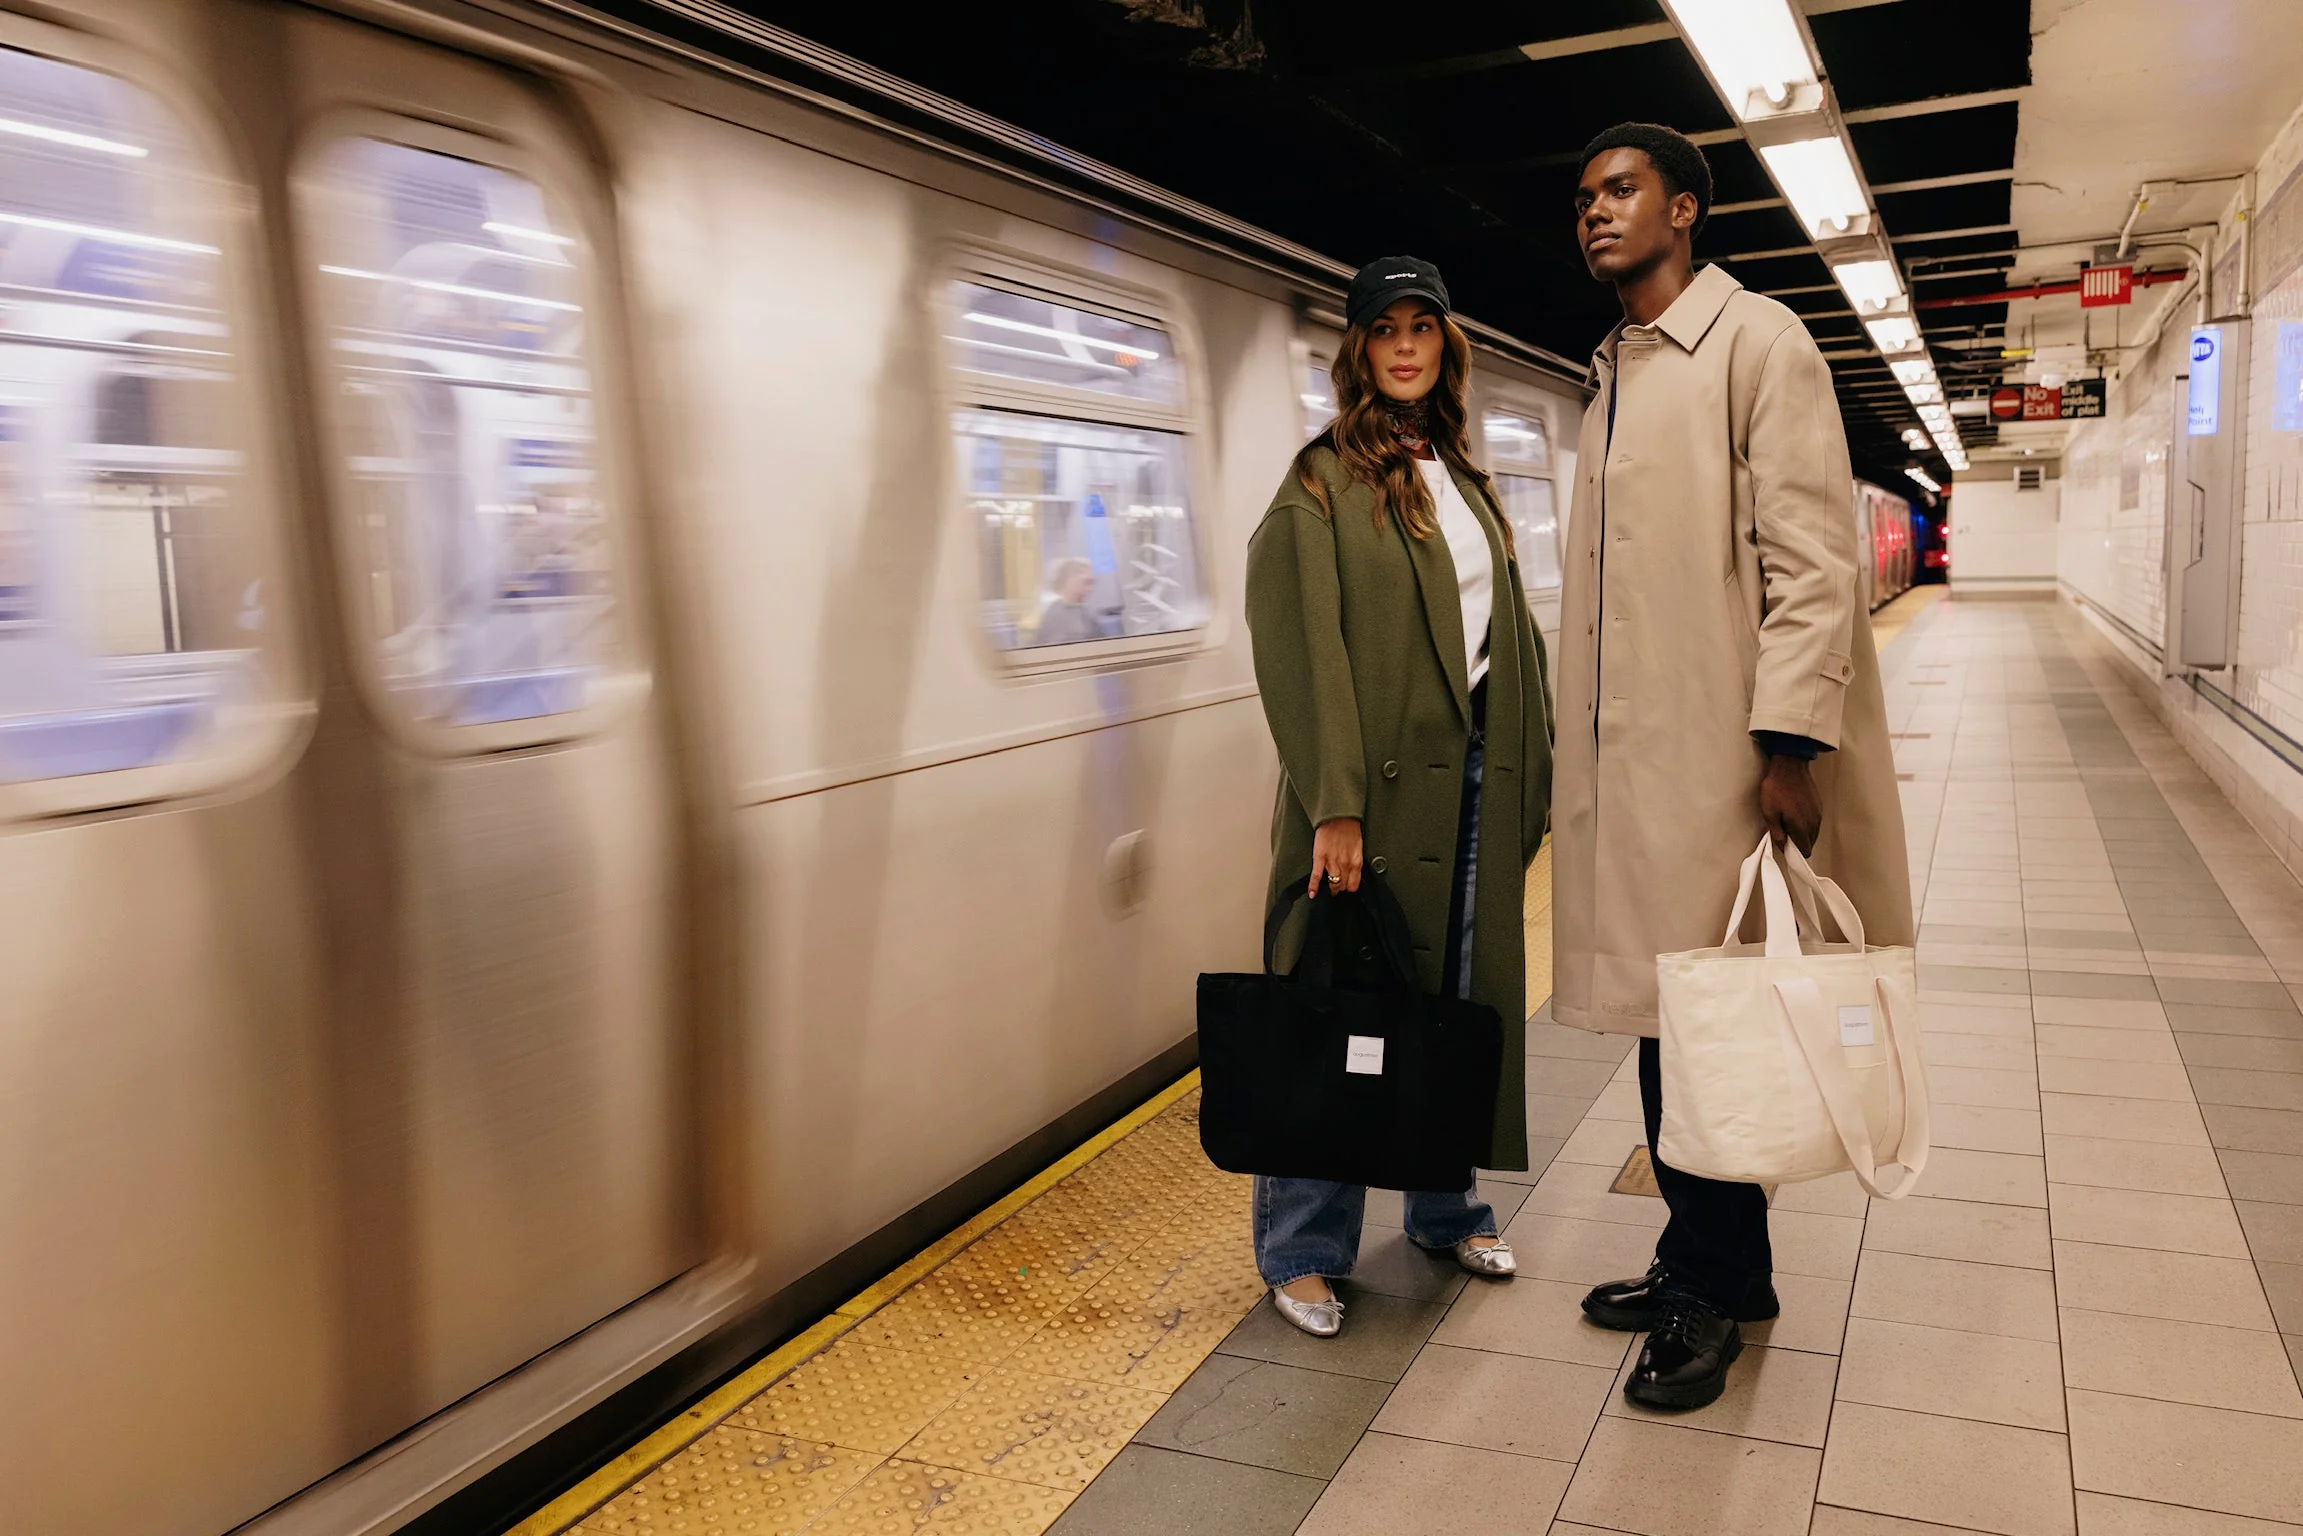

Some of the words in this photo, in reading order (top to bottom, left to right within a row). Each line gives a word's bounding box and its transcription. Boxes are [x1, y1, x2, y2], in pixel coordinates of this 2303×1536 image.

[2023, 386, 2048, 401] No
[2061, 385, 2084, 396] Exit
[2061, 394, 2100, 406] middle
[2023, 402, 2055, 416] Exit
[2061, 406, 2074, 417] of
[2077, 405, 2100, 417] plat
